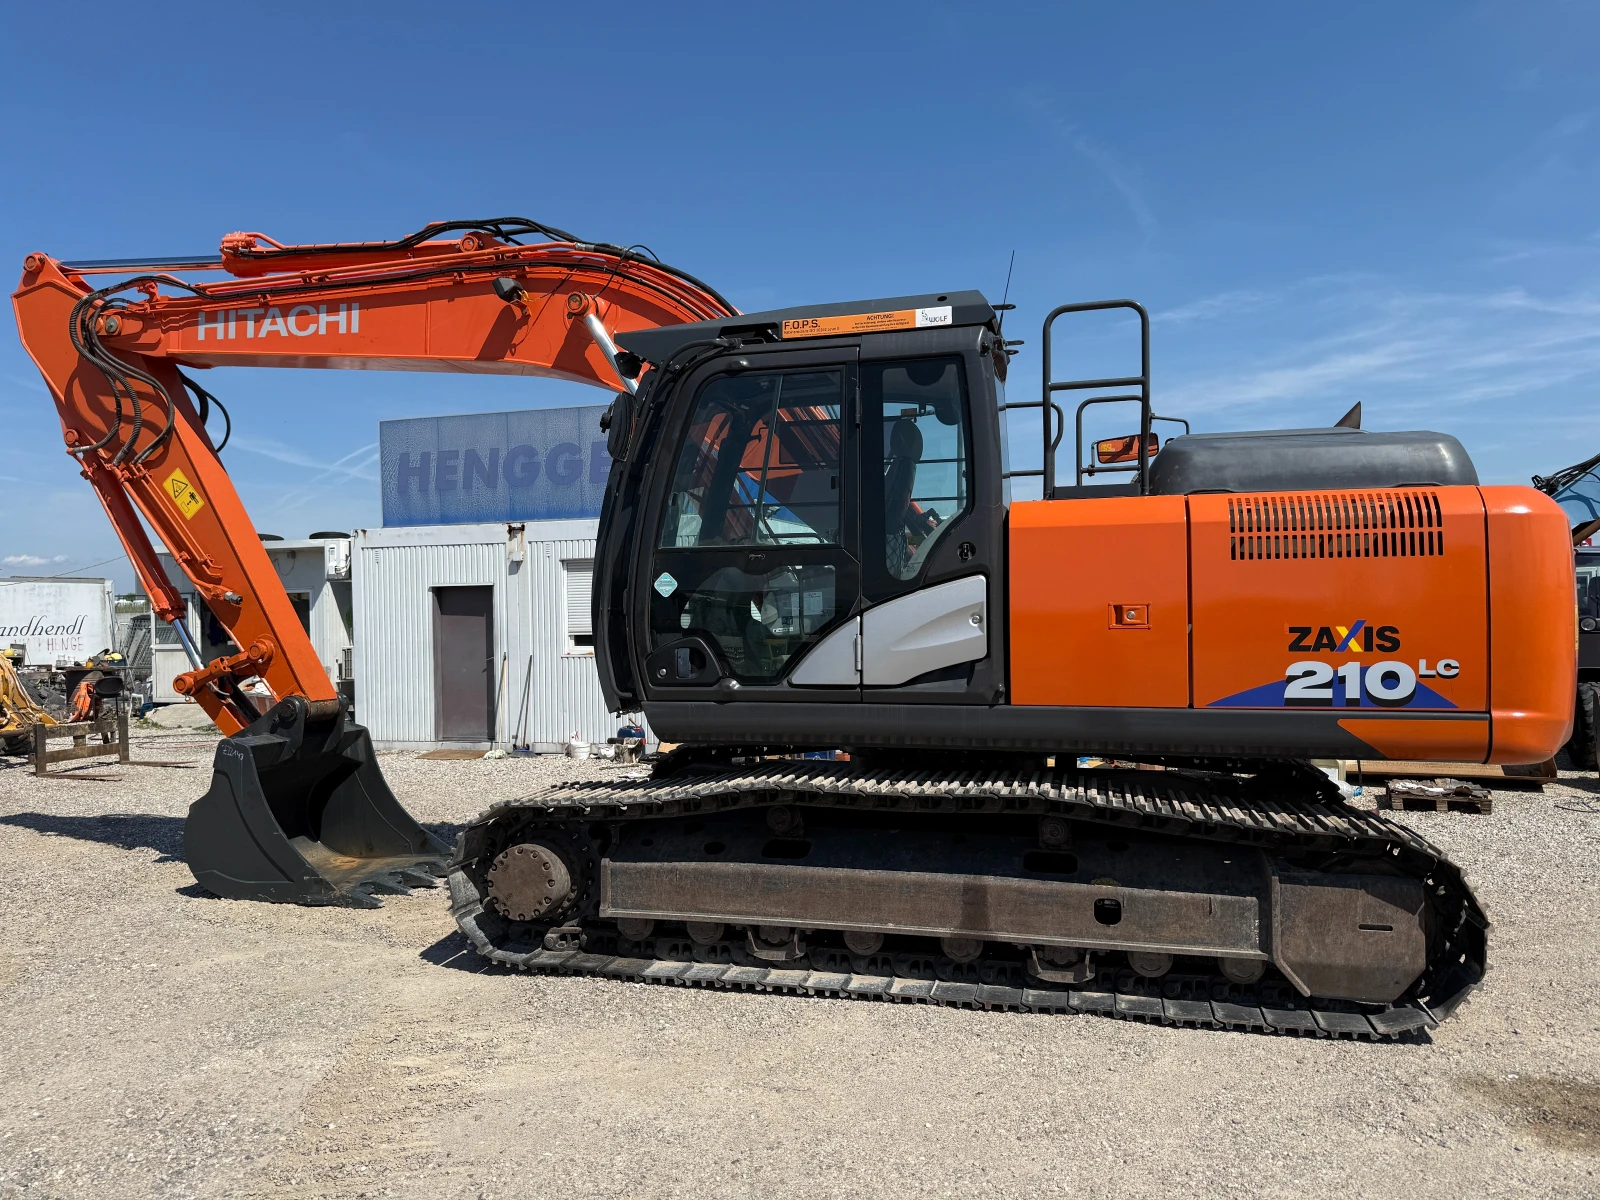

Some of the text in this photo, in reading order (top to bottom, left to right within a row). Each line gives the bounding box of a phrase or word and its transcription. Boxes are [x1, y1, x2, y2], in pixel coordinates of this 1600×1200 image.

[197, 303, 360, 341] HITACHI
[784, 319, 821, 330] F.O.P.S.
[397, 441, 610, 493] HENGGE
[1288, 619, 1401, 652] ZAXIS
